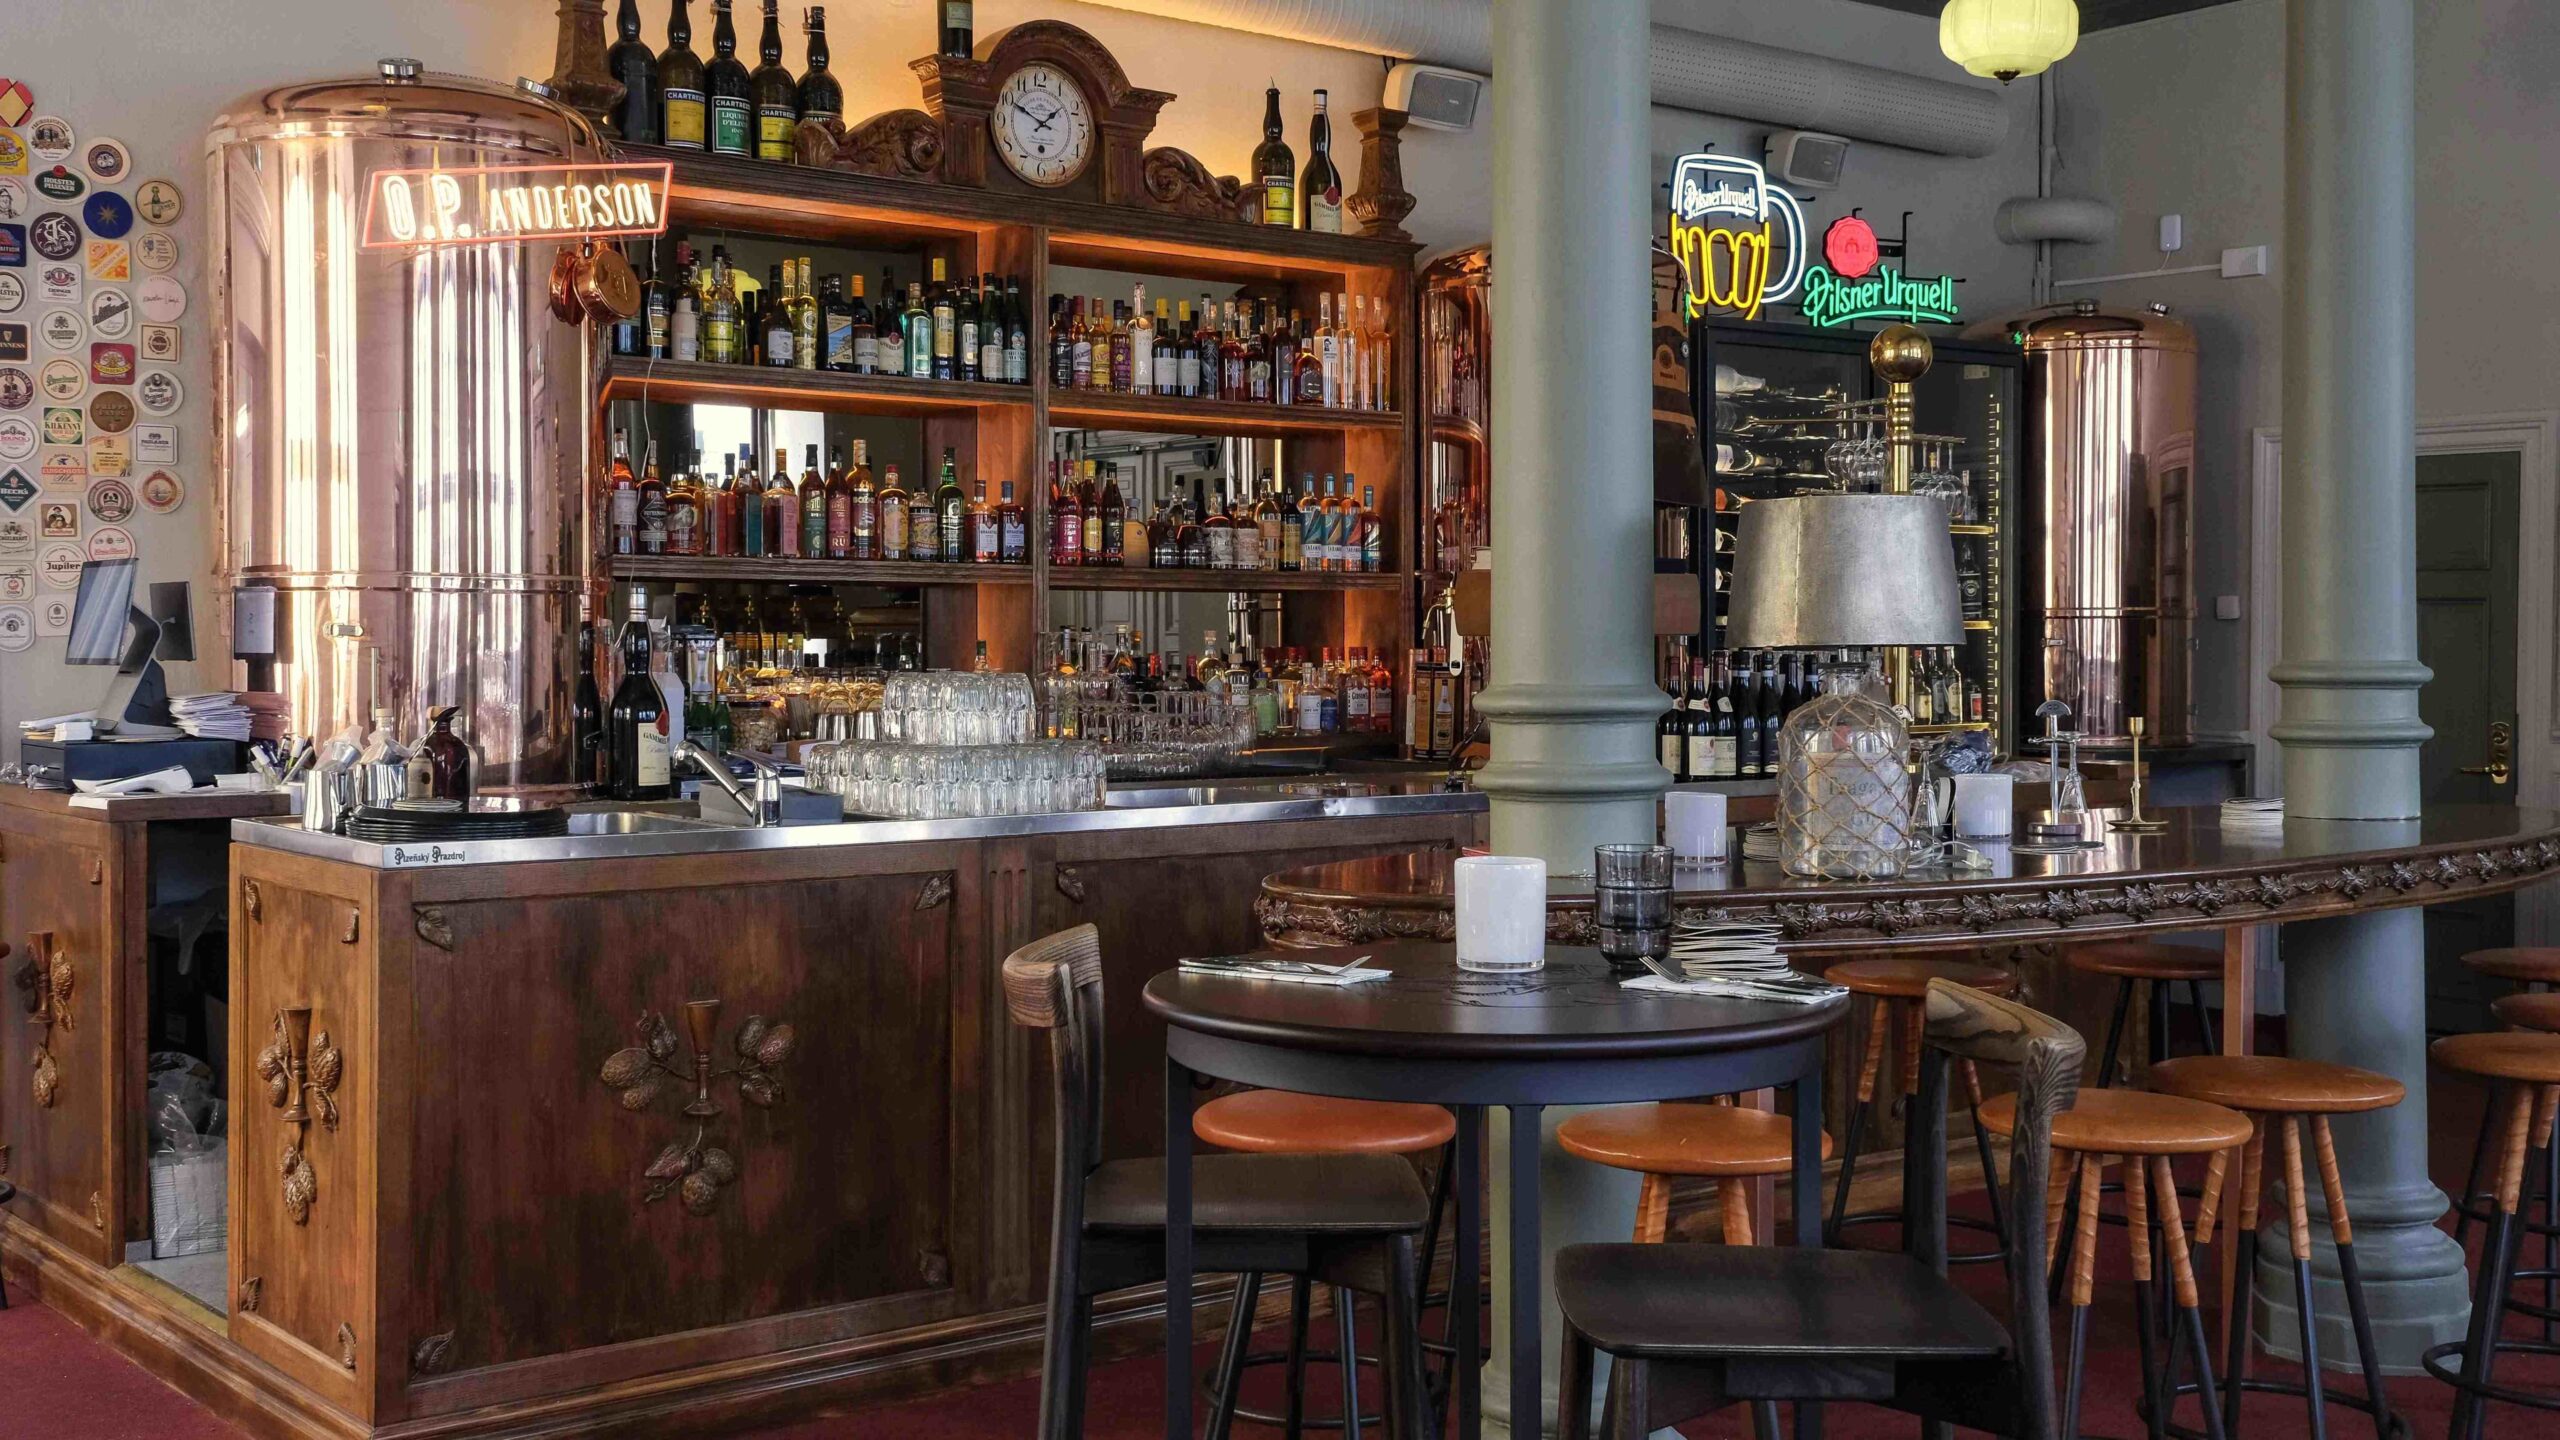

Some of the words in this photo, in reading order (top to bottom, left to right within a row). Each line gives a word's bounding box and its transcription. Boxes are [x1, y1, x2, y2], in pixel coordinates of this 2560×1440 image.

[1017, 76, 1027, 93] 11
[1034, 71, 1046, 88] 12
[1001, 91, 1014, 106] 10
[1070, 100, 1079, 116] 2
[996, 112, 1006, 129] 9
[1078, 123, 1086, 140] 3
[1003, 136, 1013, 153] 8
[1071, 143, 1081, 159] 4
[1019, 154, 1029, 171] 7
[1036, 161, 1046, 178] 6
[1058, 159, 1066, 175] 5
[43, 177, 75, 186] HOLSTEN
[43, 183, 75, 192] PILSENER
[382, 174, 473, 241] O.P.
[488, 182, 657, 232] ANDERSON
[1683, 178, 1720, 221] Pilsner
[1802, 265, 1883, 327] Pilsner
[44, 421, 82, 431] KILKENNY
[46, 562, 81, 571] Jupiler
[431, 845, 466, 864] Prazdroj
